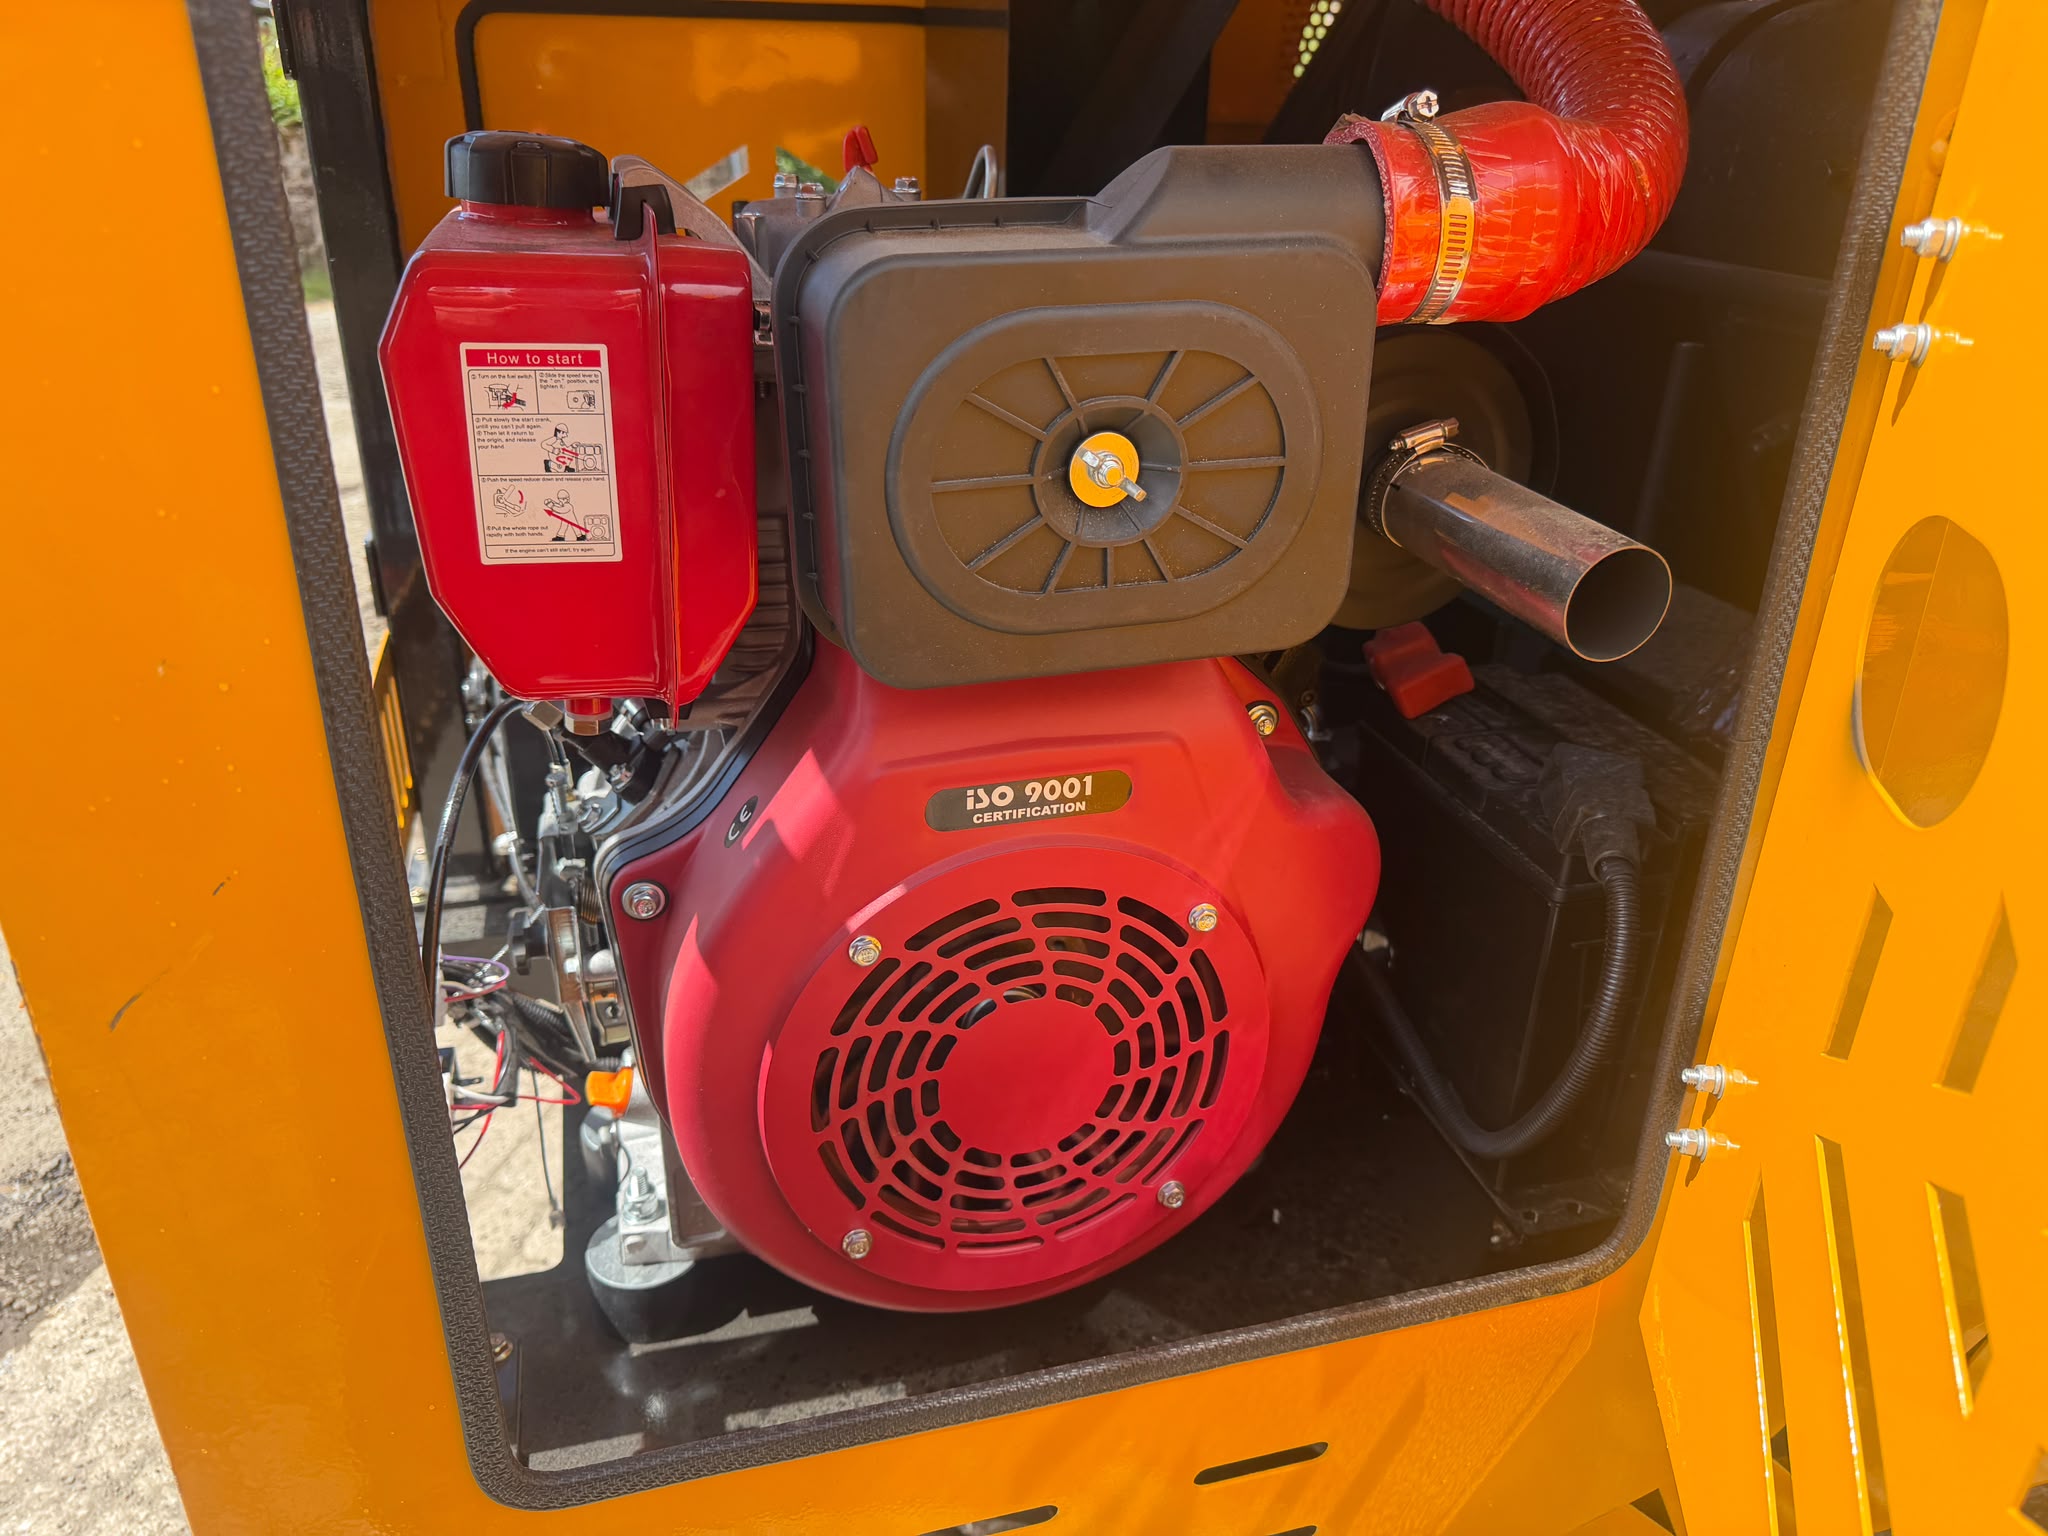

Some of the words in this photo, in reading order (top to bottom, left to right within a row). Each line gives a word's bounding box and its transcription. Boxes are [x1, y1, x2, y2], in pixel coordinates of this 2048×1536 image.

[487, 352, 519, 365] How
[526, 353, 540, 365] to
[547, 353, 583, 365] start
[1025, 775, 1093, 803] 9001
[972, 801, 1086, 824] CERTIFICATION
